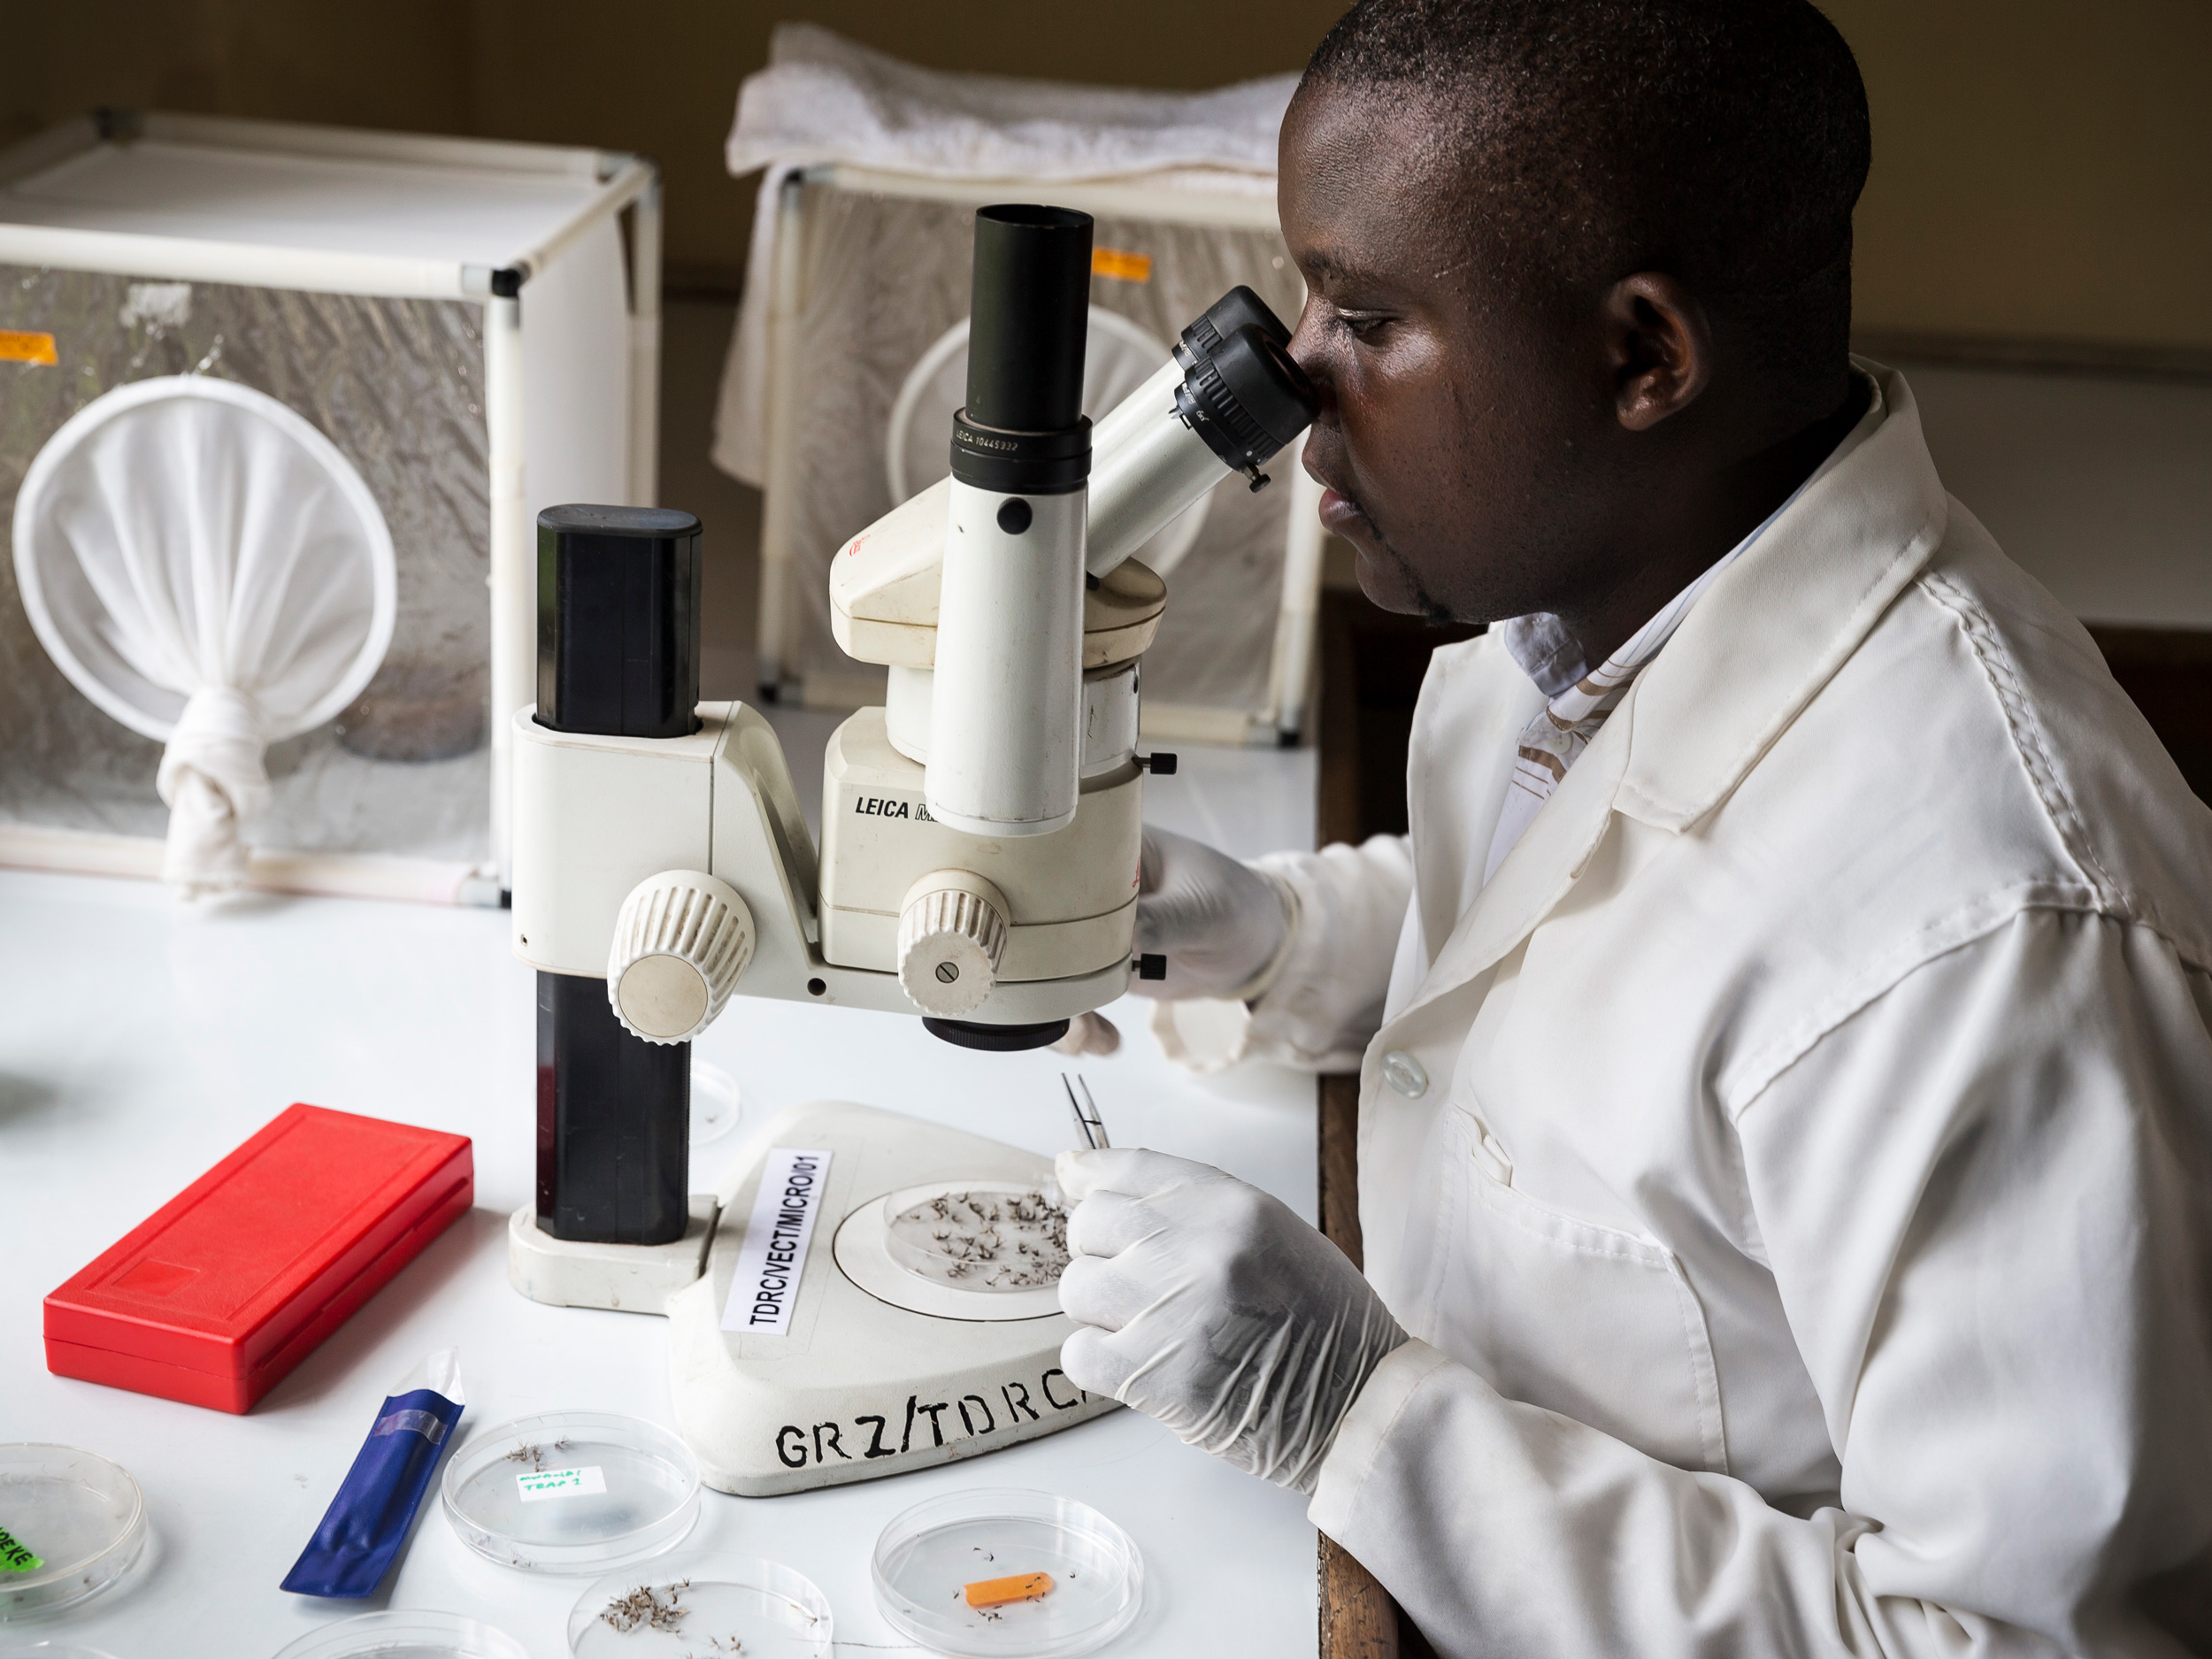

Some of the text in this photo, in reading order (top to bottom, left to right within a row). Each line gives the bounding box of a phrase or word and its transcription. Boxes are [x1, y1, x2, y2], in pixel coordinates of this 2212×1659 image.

[956, 429, 1018, 451] LEICA 10445932
[855, 796, 909, 819] LEICA
[749, 1156, 819, 1325] TDRC/VECT/MICRO/01
